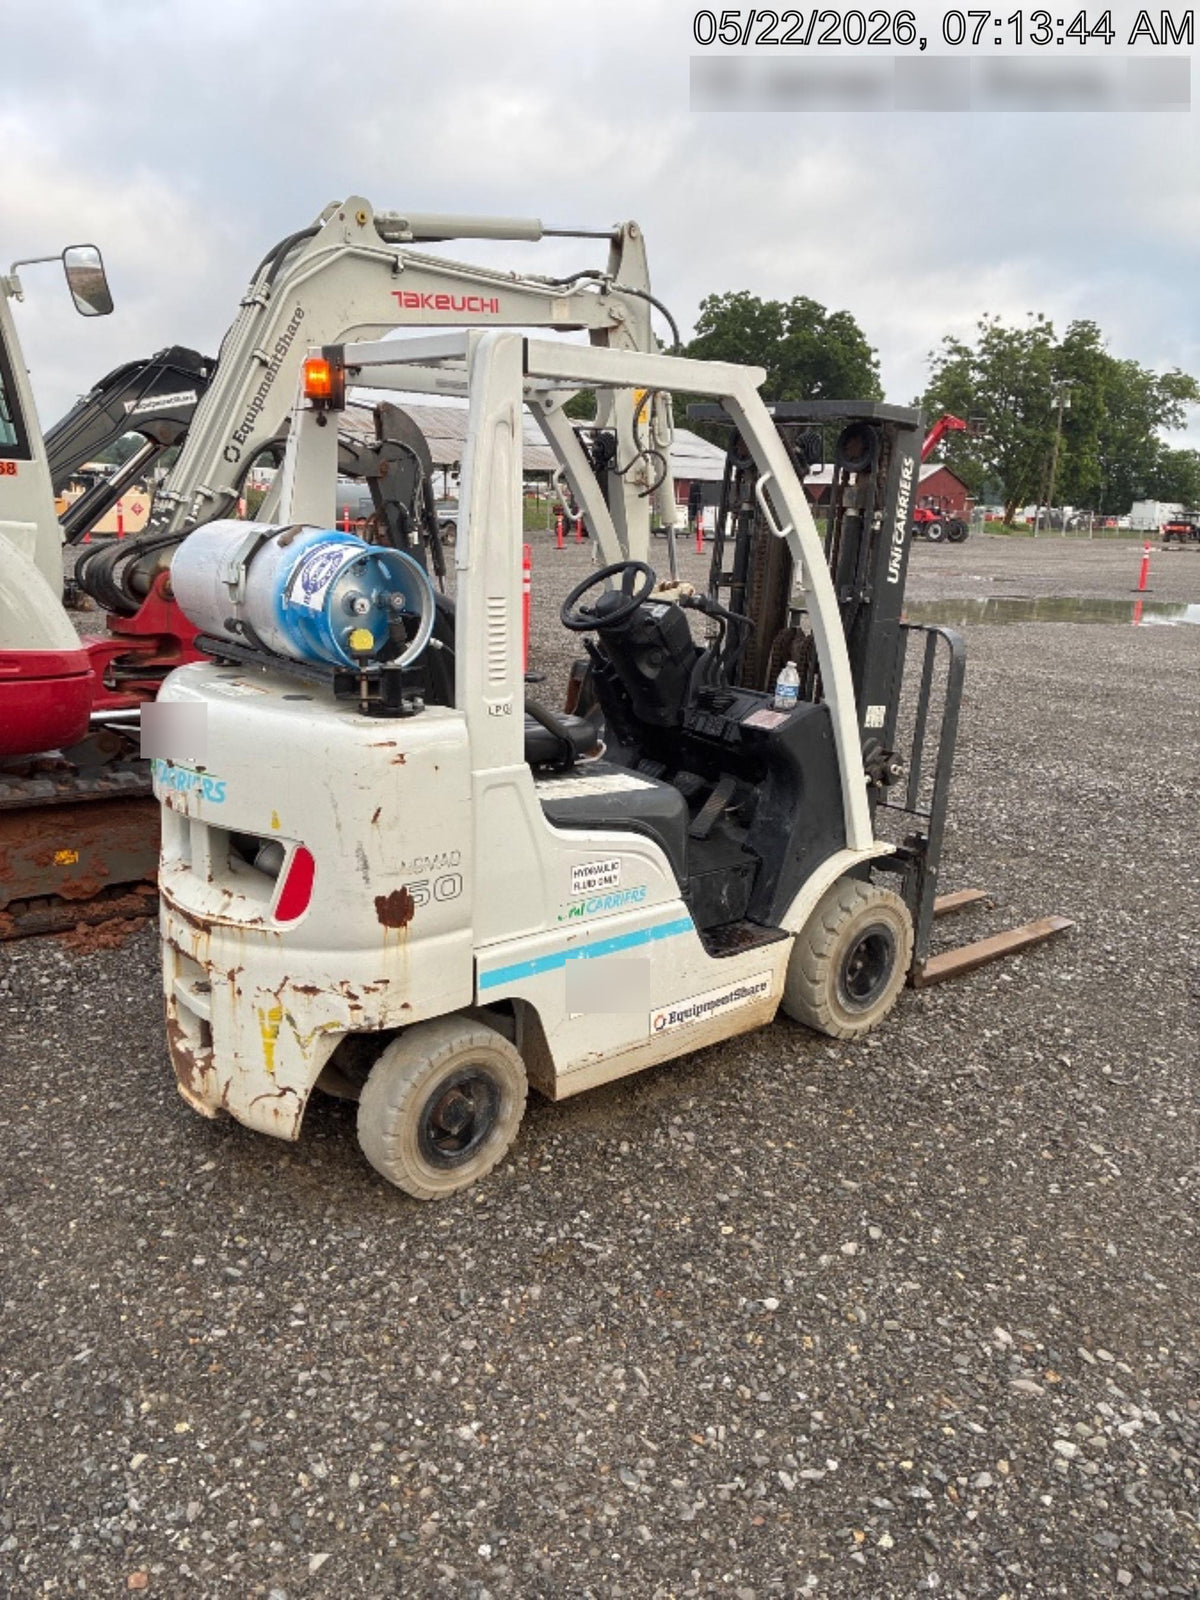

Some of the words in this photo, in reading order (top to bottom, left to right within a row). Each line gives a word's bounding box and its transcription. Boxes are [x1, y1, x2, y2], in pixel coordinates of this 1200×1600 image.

[391, 291, 499, 313] TAKEUCHI
[233, 306, 305, 446] EquipmentShare
[887, 455, 915, 583] UNICARRIERS
[402, 873, 463, 908] 50
[668, 981, 768, 1025] EquipmentShare
